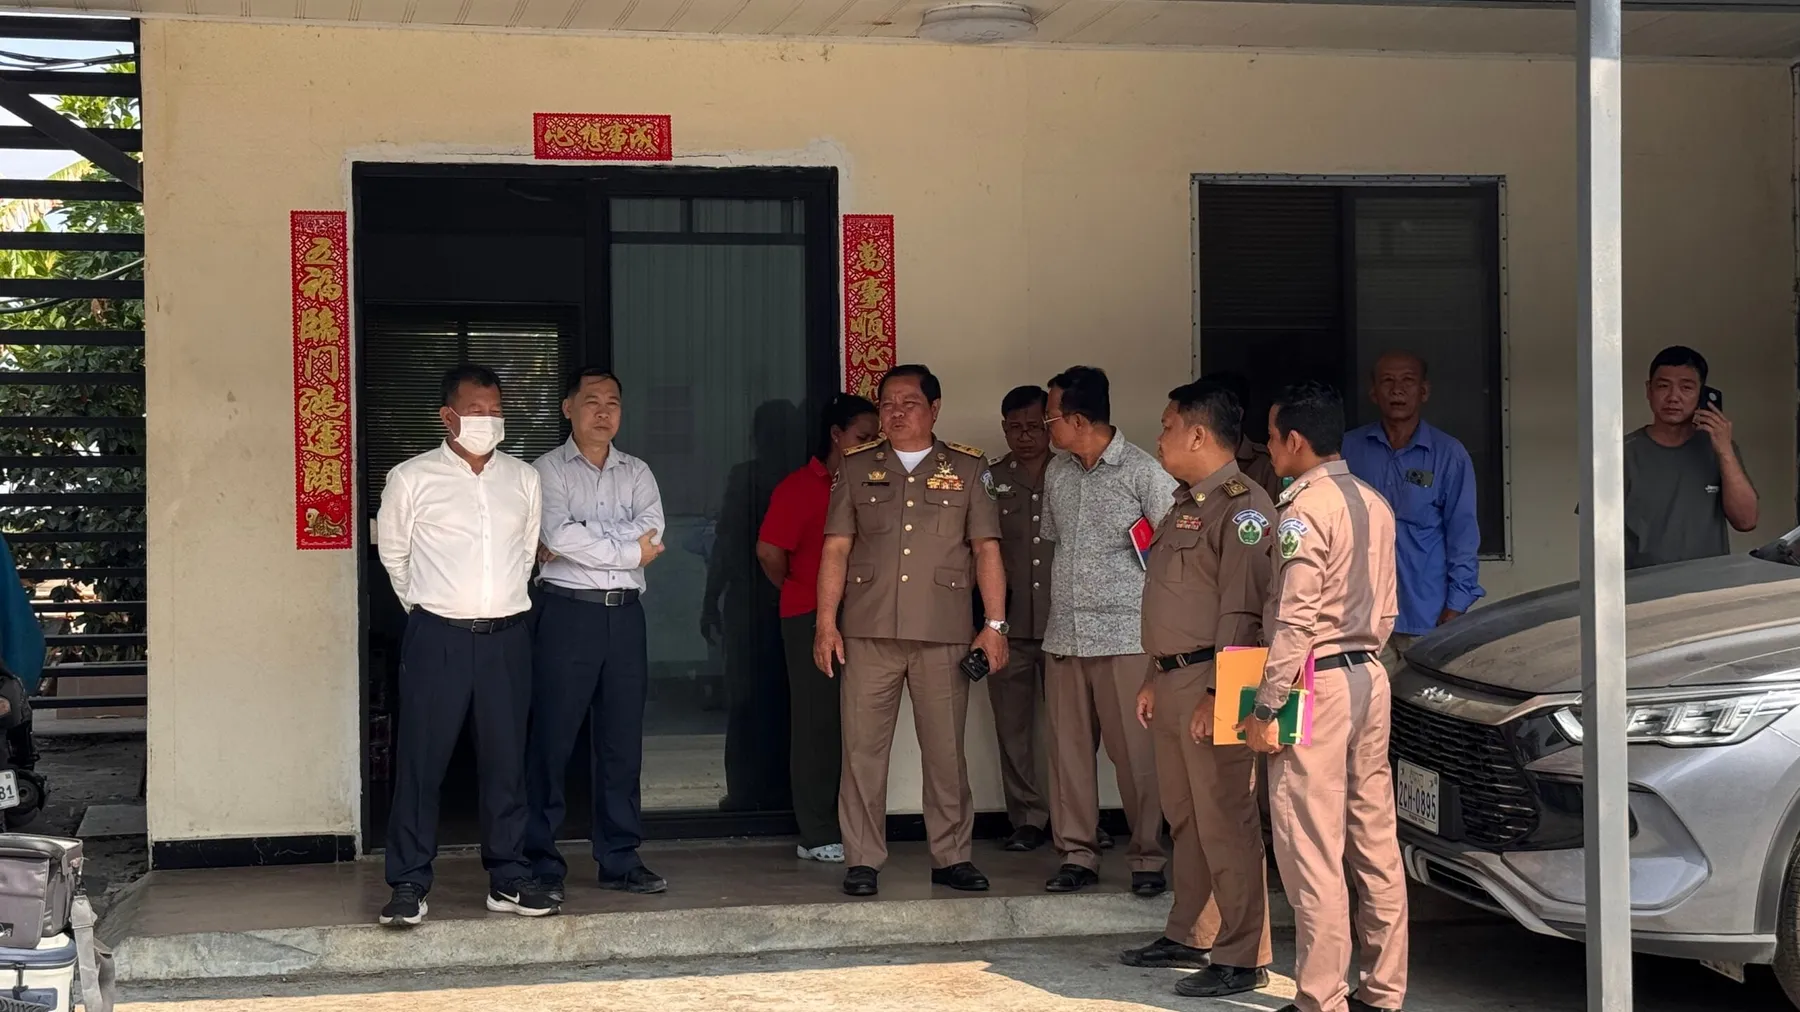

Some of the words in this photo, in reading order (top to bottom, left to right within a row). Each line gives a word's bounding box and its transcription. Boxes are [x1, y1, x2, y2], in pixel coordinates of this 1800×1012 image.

[544, 122, 660, 154] 心想事成
[1399, 780, 1436, 820] 2CH-0895
